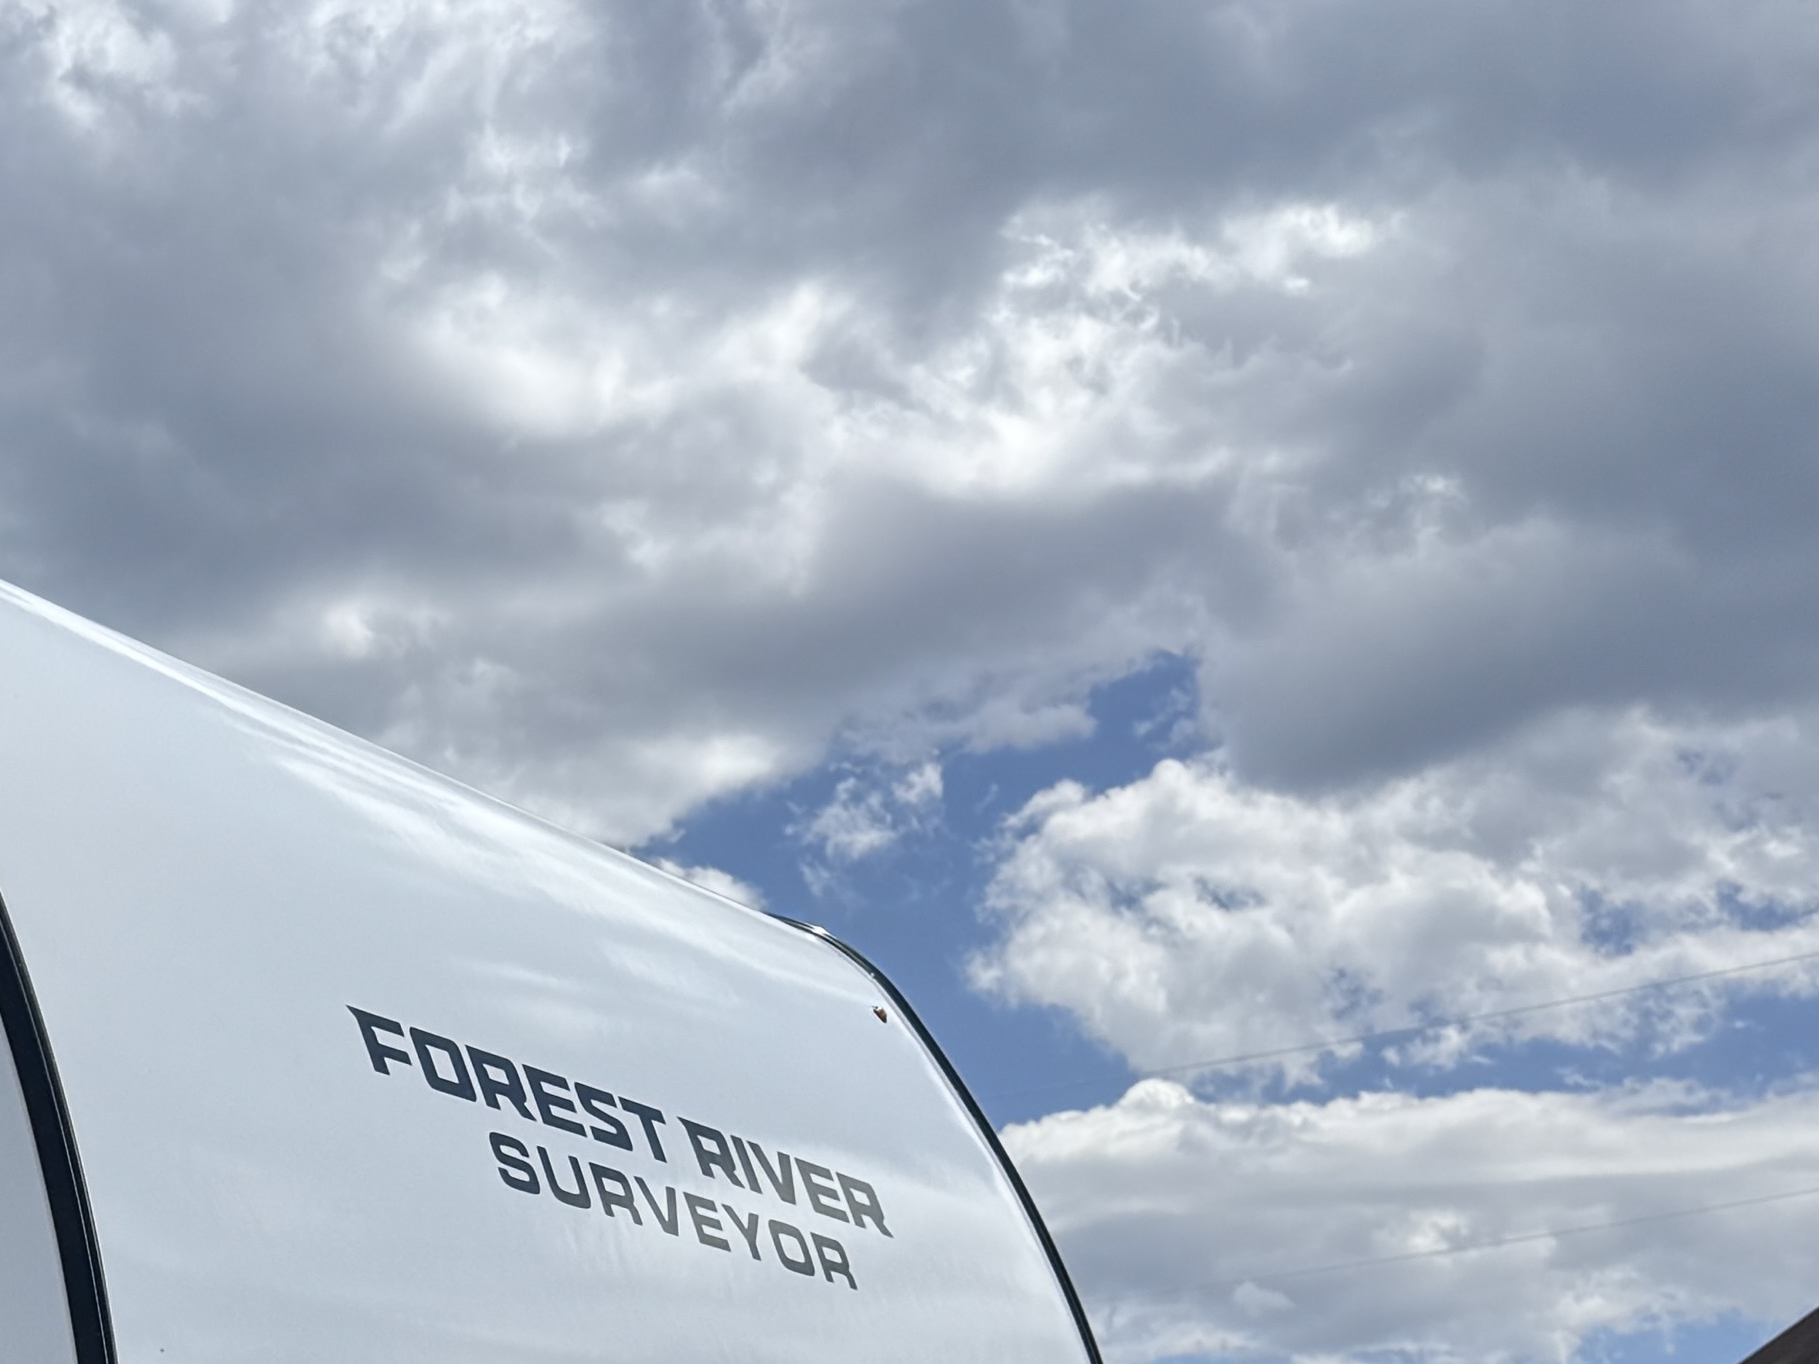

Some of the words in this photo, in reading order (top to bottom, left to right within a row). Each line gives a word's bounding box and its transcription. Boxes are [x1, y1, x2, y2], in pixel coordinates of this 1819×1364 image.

[345, 1003, 668, 1164] FOREST
[676, 1115, 894, 1239] RIVER
[488, 1130, 859, 1291] SURVEYOR
